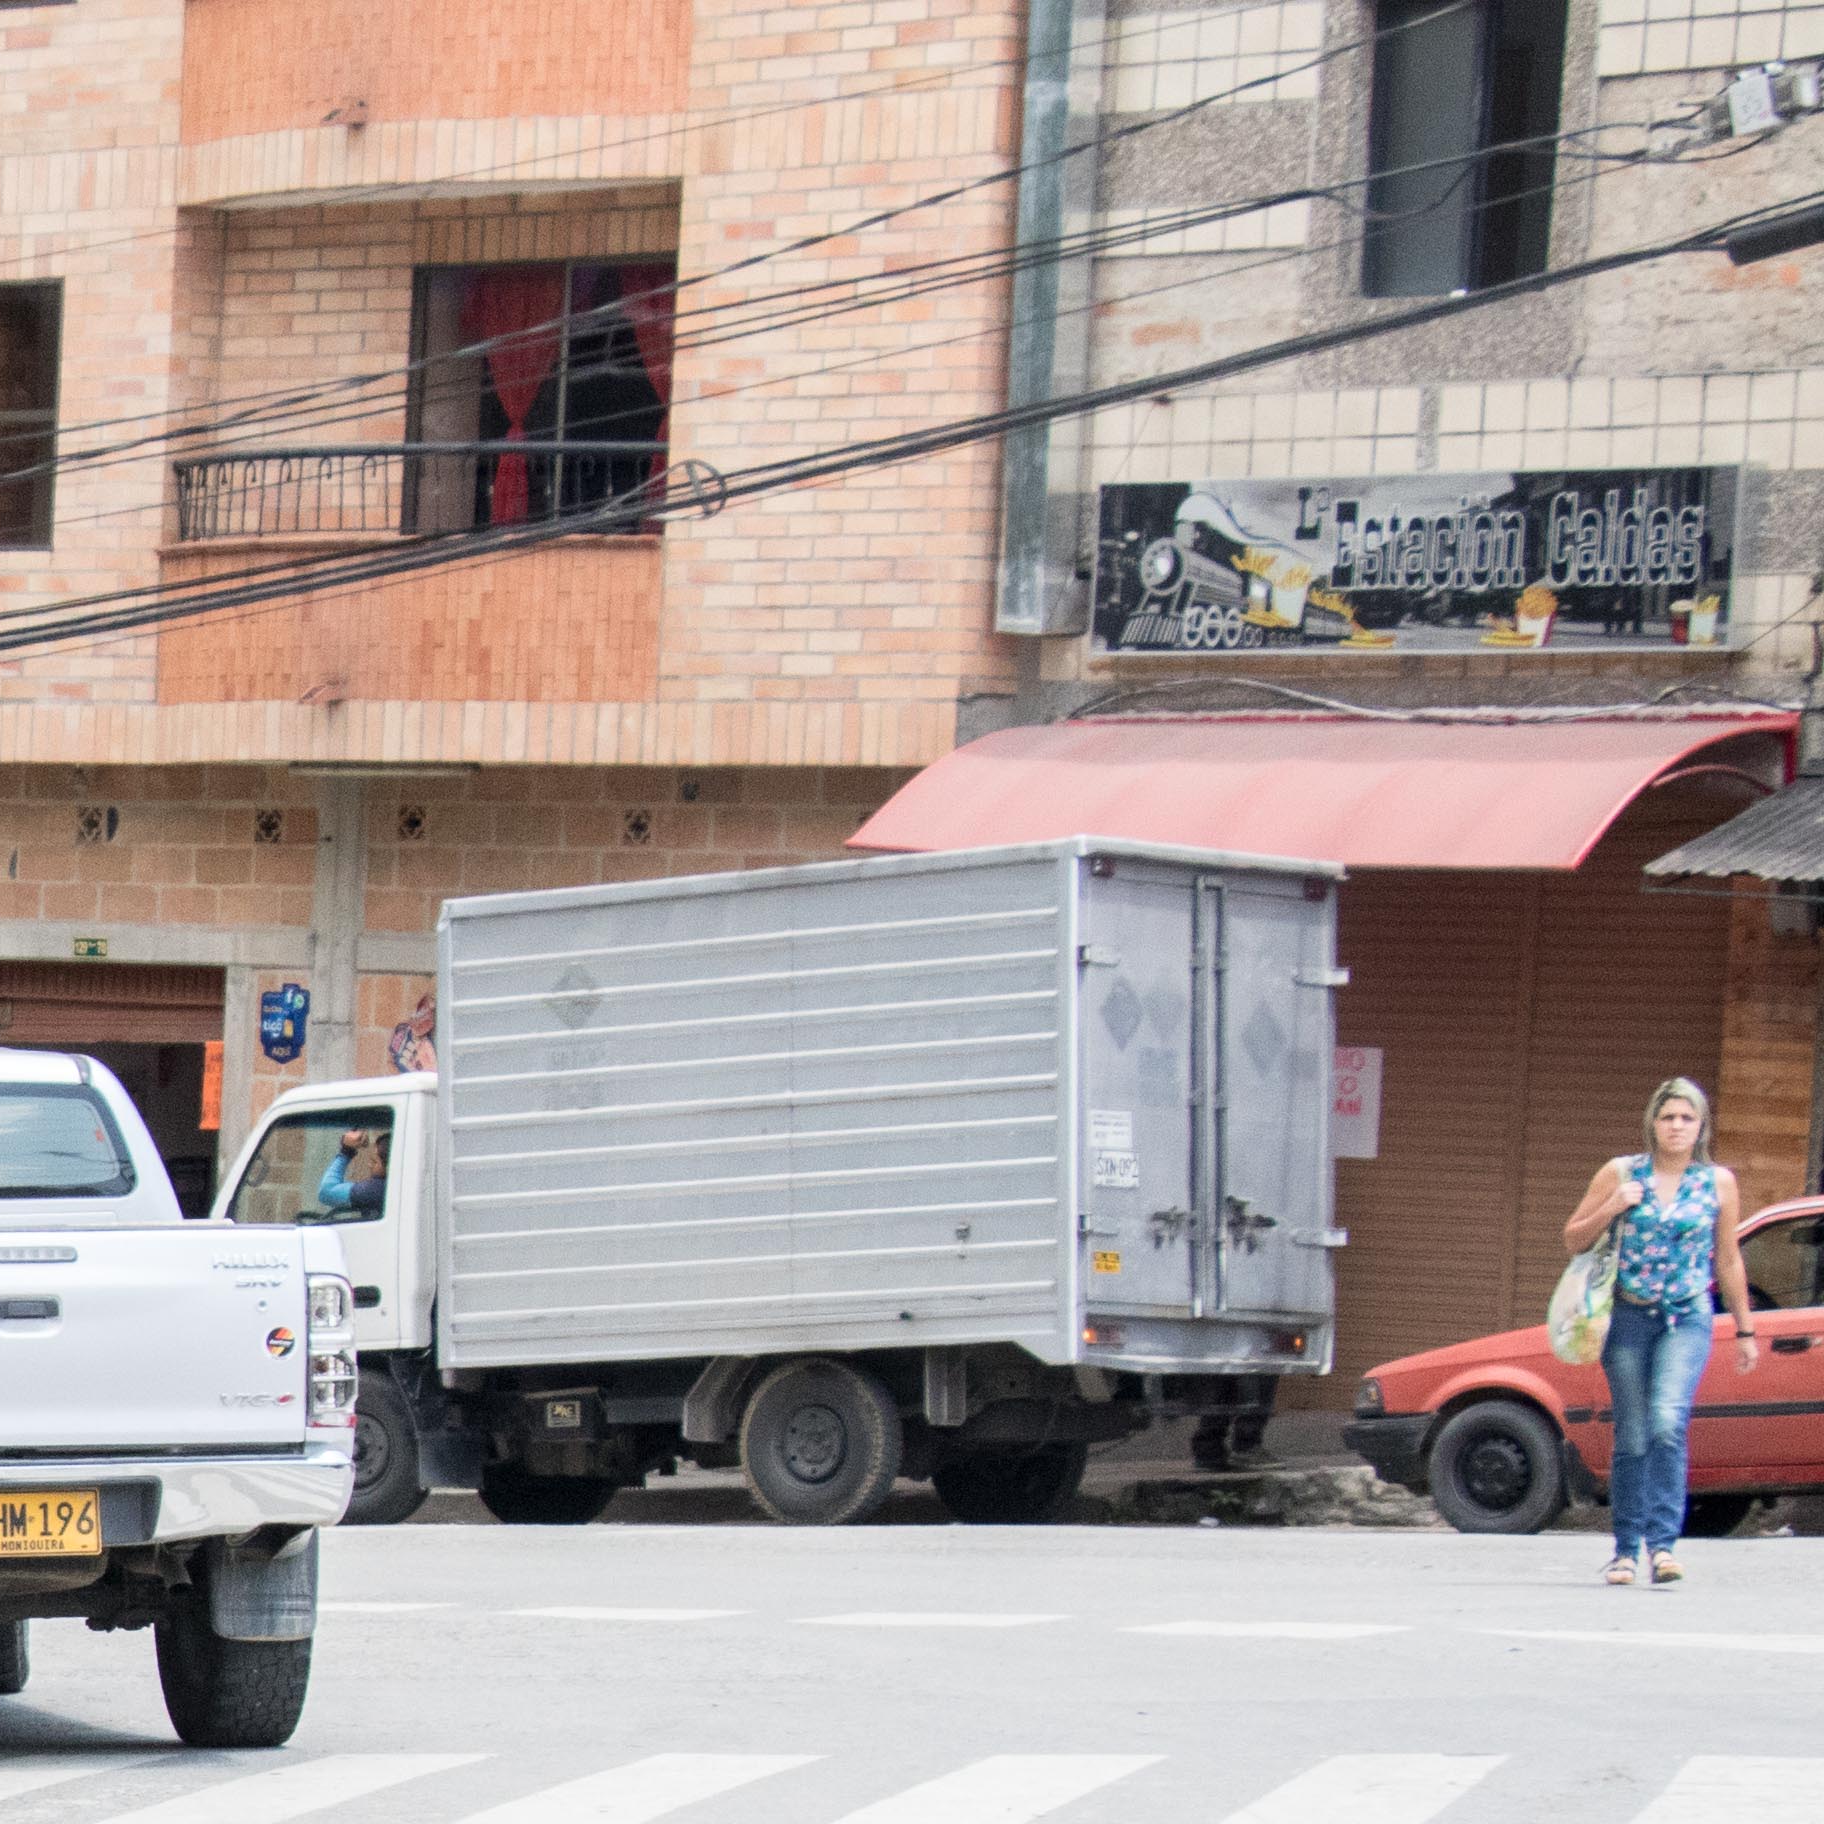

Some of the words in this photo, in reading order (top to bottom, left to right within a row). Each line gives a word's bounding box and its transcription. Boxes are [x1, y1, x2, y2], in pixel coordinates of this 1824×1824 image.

[1330, 494, 1526, 589] Estación
[1549, 487, 1704, 587] Caldas
[212, 1253, 289, 1270] HILUX
